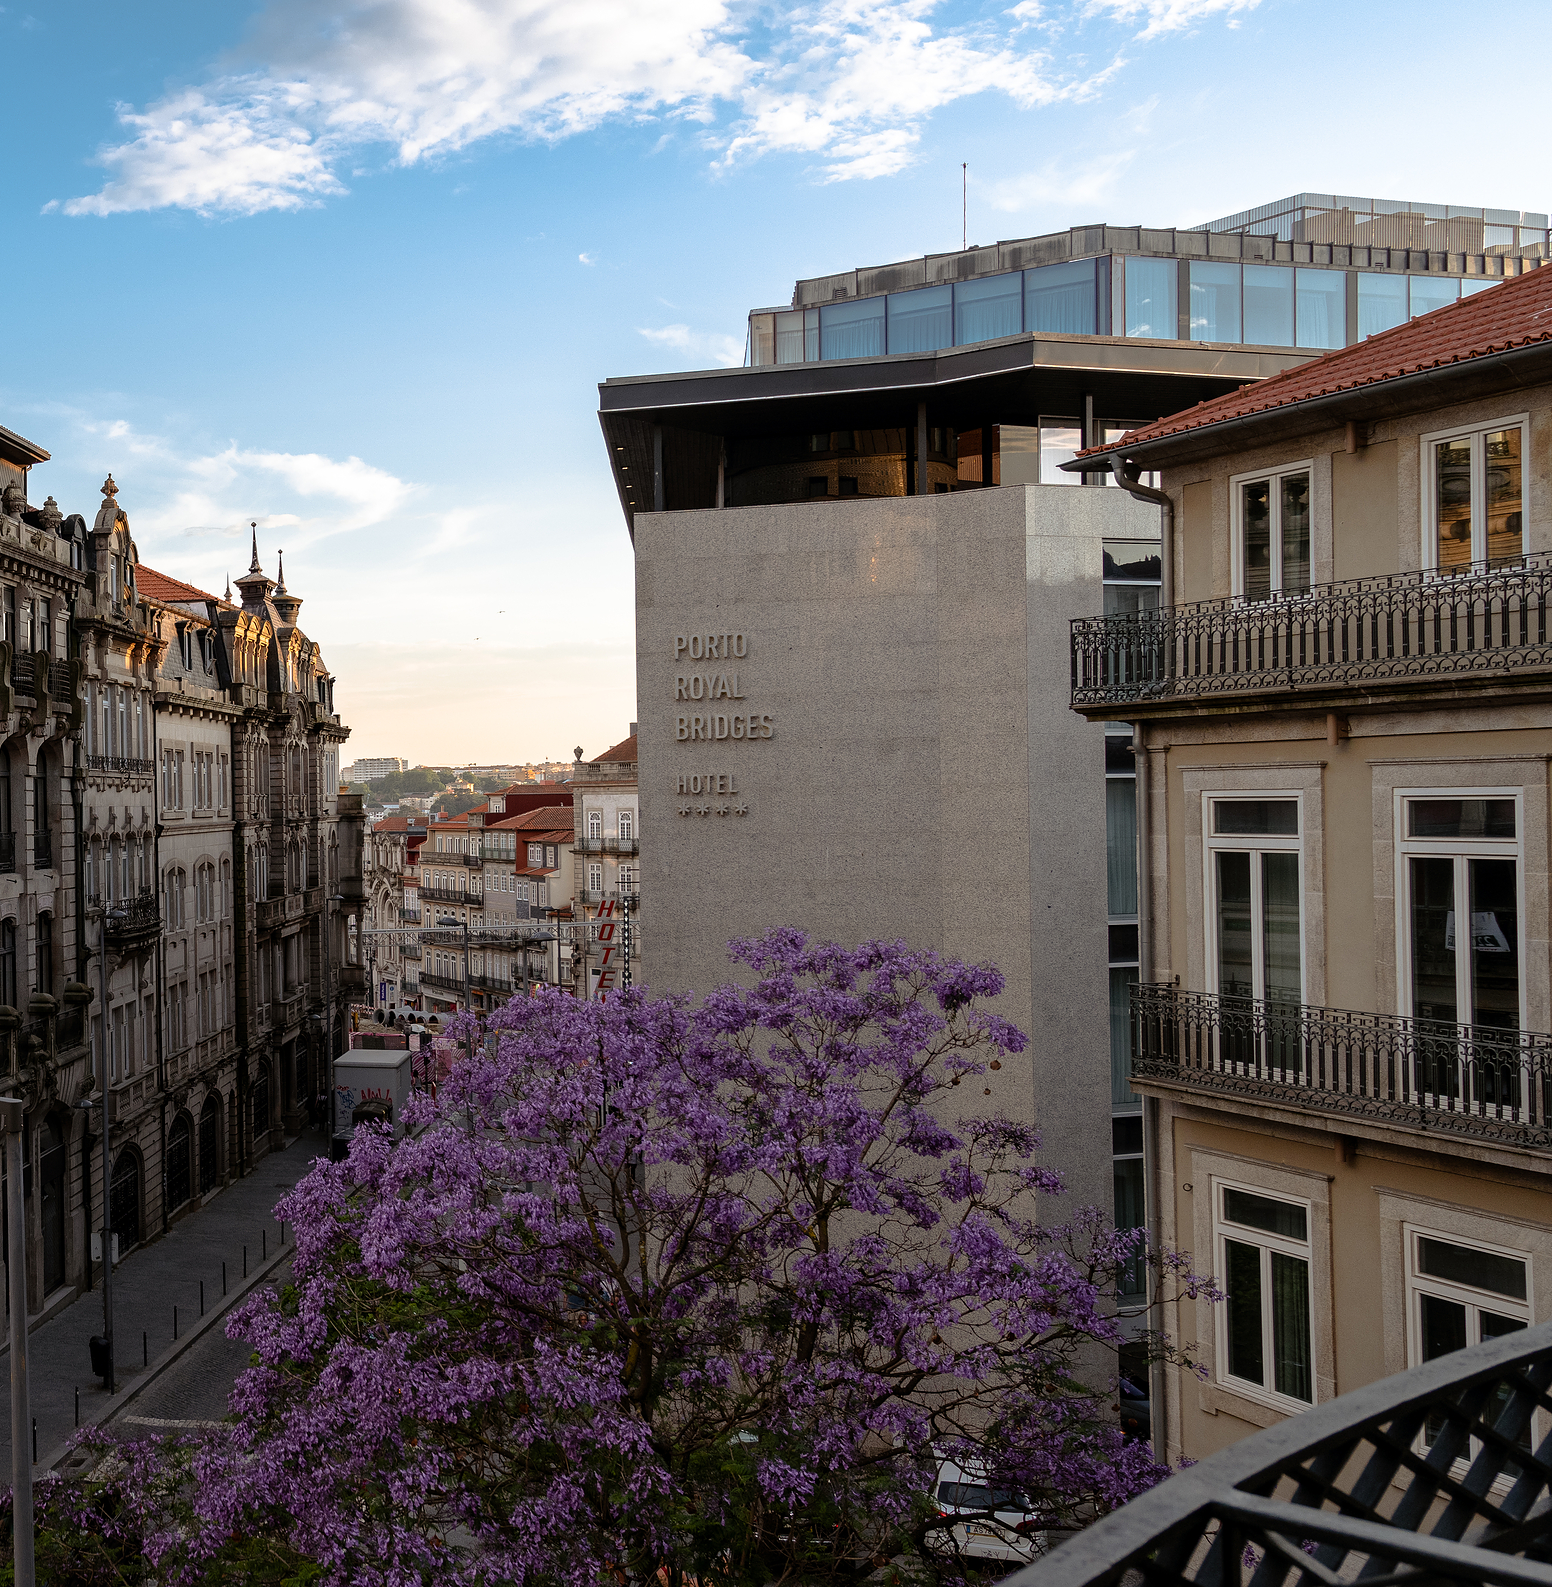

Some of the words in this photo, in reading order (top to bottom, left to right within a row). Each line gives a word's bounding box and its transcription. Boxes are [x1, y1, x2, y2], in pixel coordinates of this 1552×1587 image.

[674, 633, 747, 660] PORTO
[674, 673, 744, 700] ROYAL
[675, 713, 774, 740] BRIDGES
[676, 774, 738, 794] HOTEL
